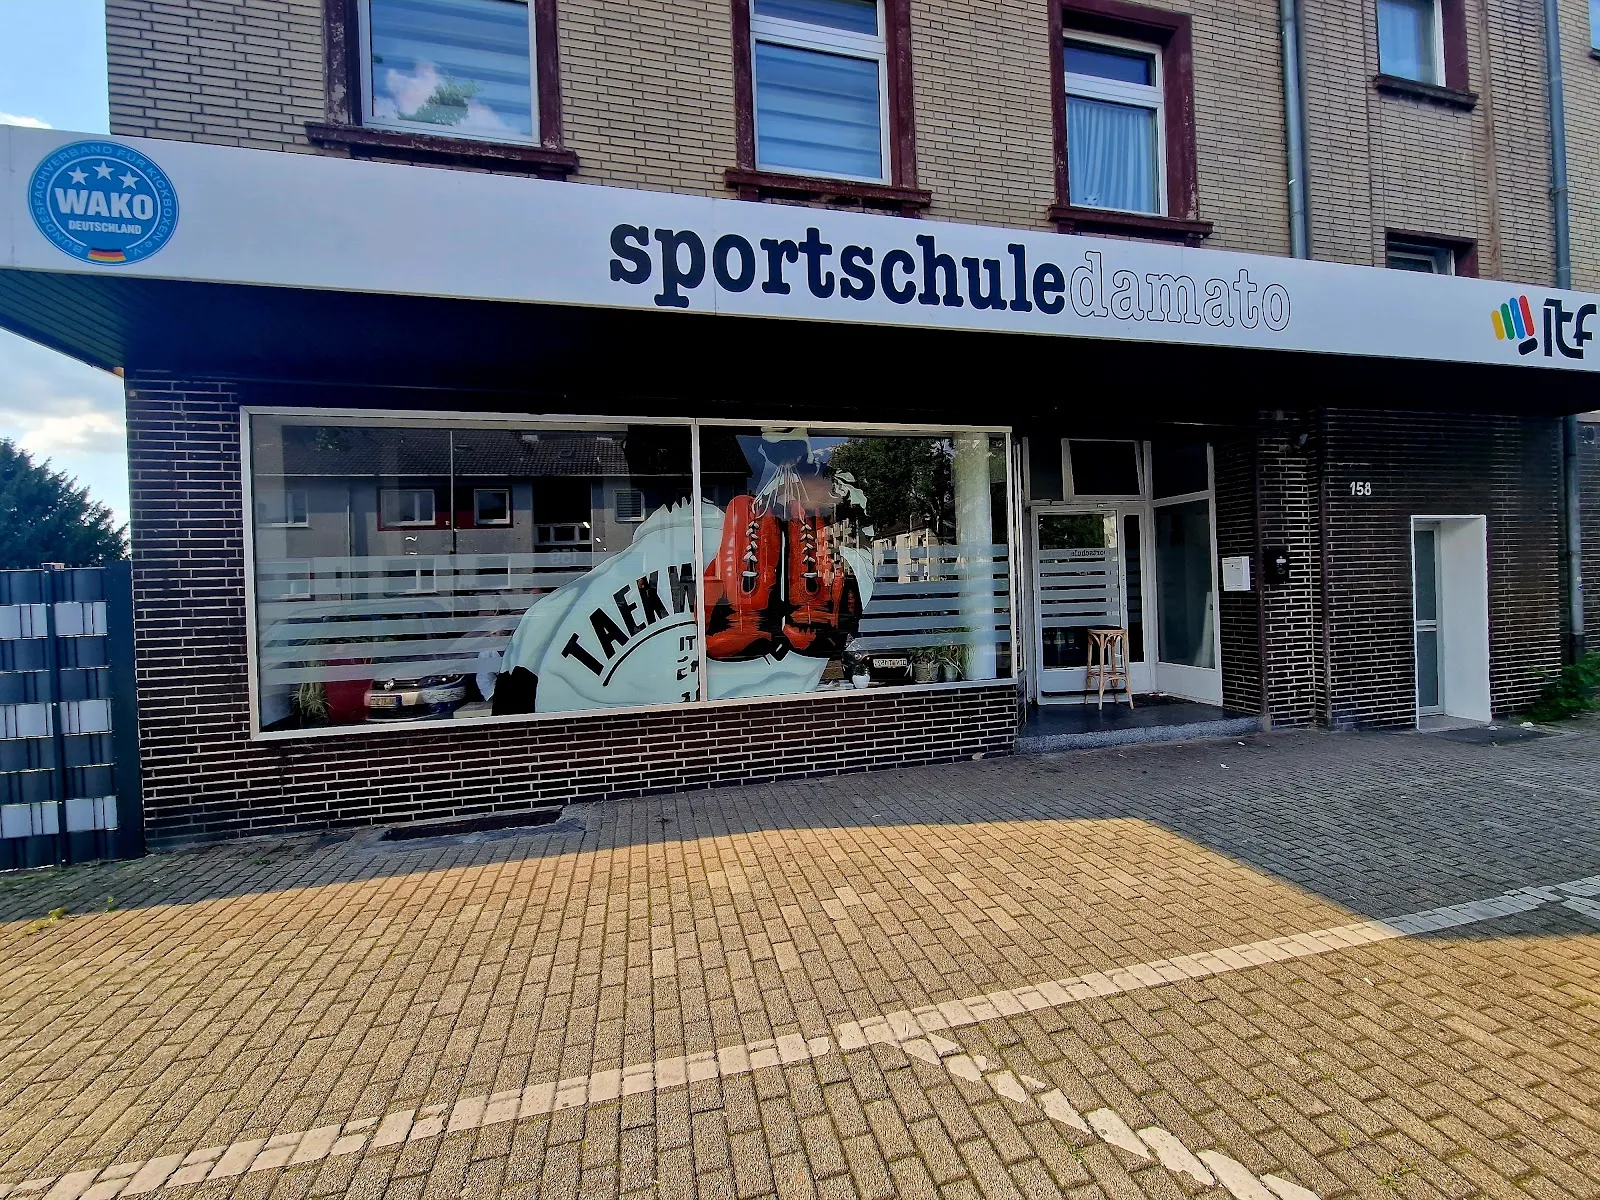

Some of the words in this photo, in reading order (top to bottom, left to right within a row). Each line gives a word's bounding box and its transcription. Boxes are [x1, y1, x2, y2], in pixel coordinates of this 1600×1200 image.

[33, 145, 113, 254] BUNDESFACHVERBAND
[117, 148, 146, 169] FÜR
[146, 167, 173, 243] KICKBOXEN
[54, 187, 154, 220] WAKO
[68, 219, 142, 235] DEUTSCHLAND
[609, 223, 1066, 315] sportschule
[1069, 250, 1292, 332] damato
[1350, 481, 1372, 496] 158
